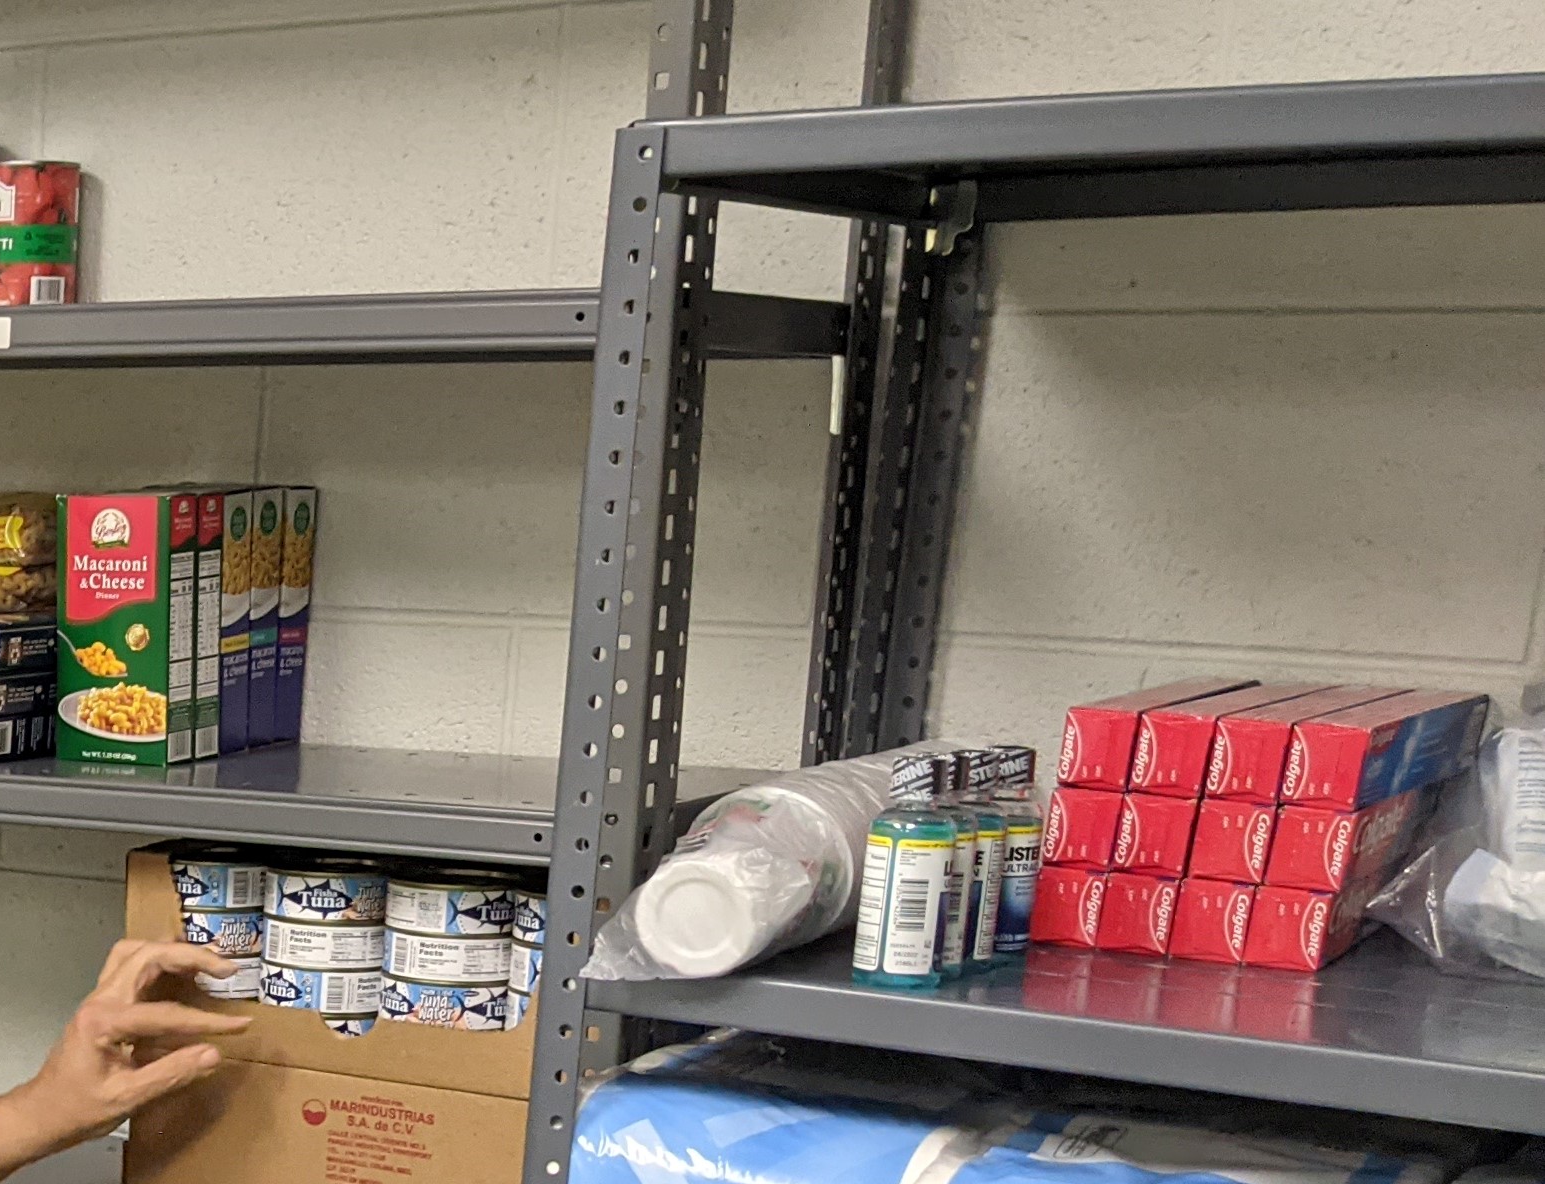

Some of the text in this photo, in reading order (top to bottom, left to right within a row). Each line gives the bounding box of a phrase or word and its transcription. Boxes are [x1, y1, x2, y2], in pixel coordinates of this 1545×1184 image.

[73, 555, 148, 572] Macaroni
[1058, 724, 1076, 779] Colgate
[1132, 728, 1151, 784] Colgate
[1206, 735, 1226, 791] Colgate
[1282, 740, 1303, 796] Colgate
[1043, 804, 1062, 858] Colgate
[1114, 809, 1134, 864] Colgate
[1250, 813, 1271, 869] Colgate
[1330, 820, 1351, 877] Colgate
[298, 890, 346, 908] Tuna
[1084, 880, 1105, 934] Colgate
[1155, 886, 1175, 942] Colgate
[1231, 894, 1251, 949] Colgate
[290, 929, 327, 938] Nutrition
[419, 941, 460, 950] Nutrition
[419, 948, 444, 957] Facts
[1307, 901, 1328, 957] Colgate
[262, 977, 296, 999] Tuna
[420, 994, 449, 1008] Tuna
[330, 1099, 435, 1125] MARINDUSTRIAS
[346, 1115, 370, 1129] S.A.
[374, 1120, 388, 1132] de
